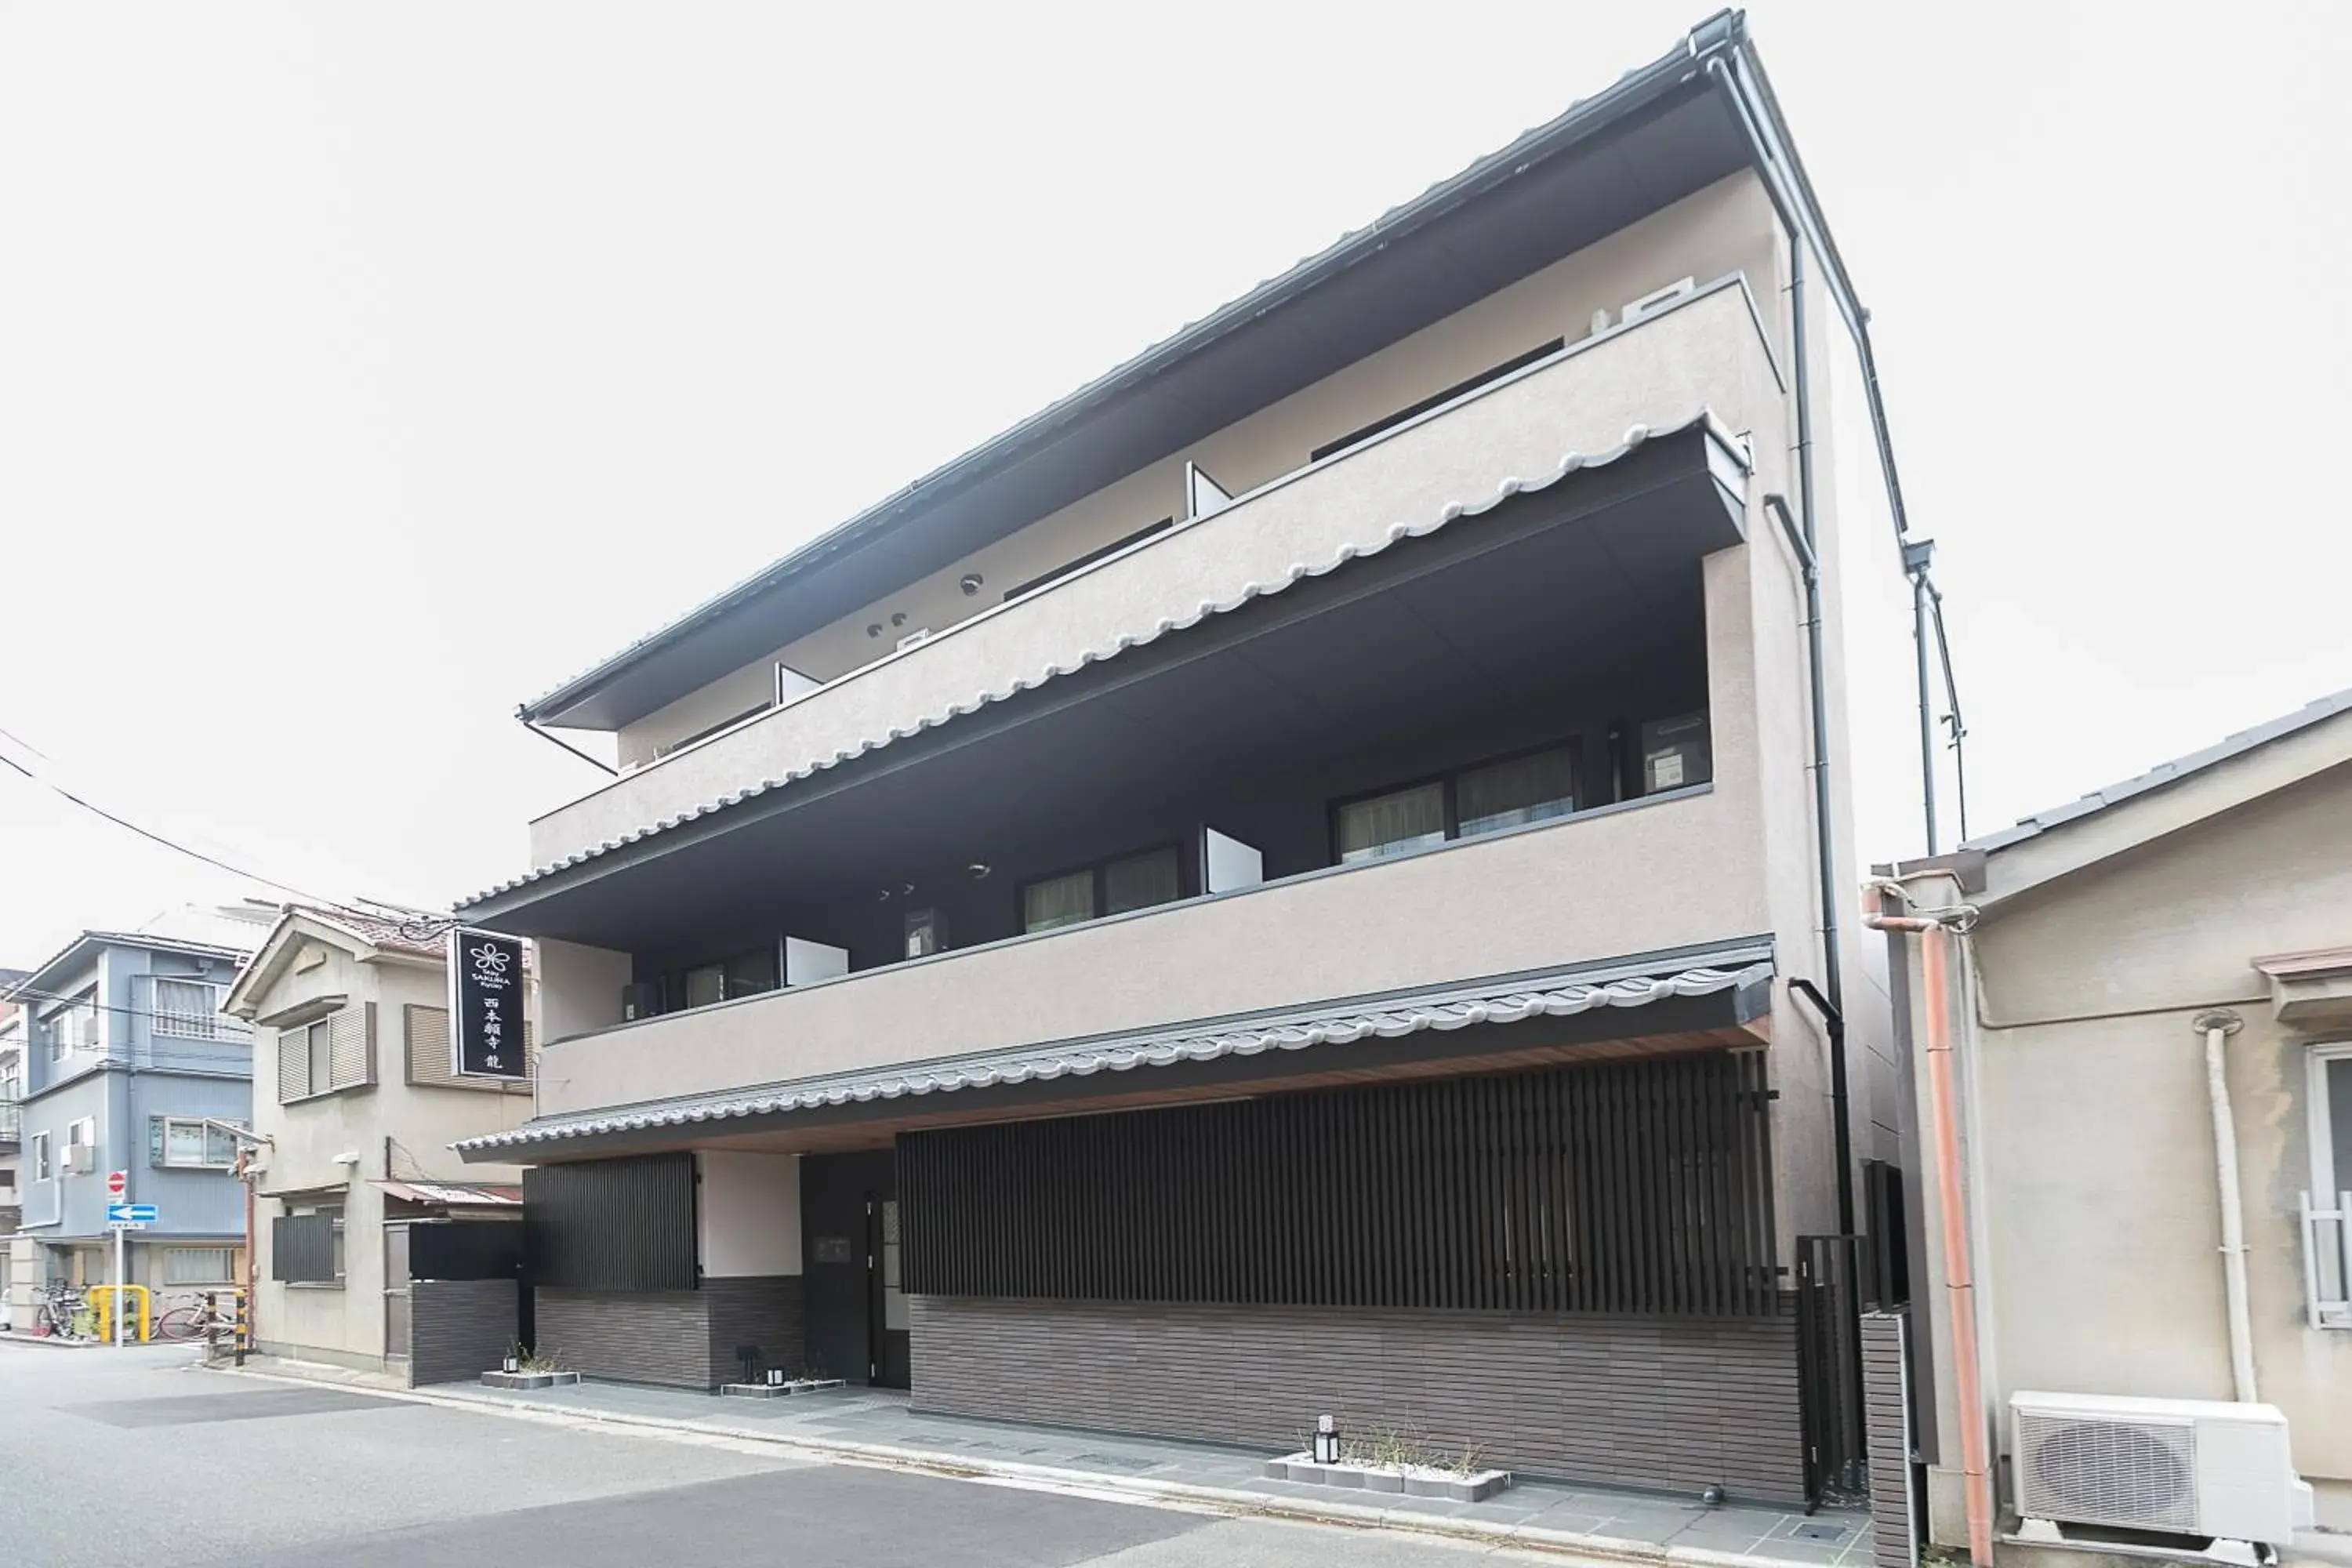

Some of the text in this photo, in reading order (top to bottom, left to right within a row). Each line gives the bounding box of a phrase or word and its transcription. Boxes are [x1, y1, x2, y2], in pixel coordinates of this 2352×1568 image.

[472, 973, 511, 985] SAKURA
[484, 998, 502, 1049] 西本願寺
